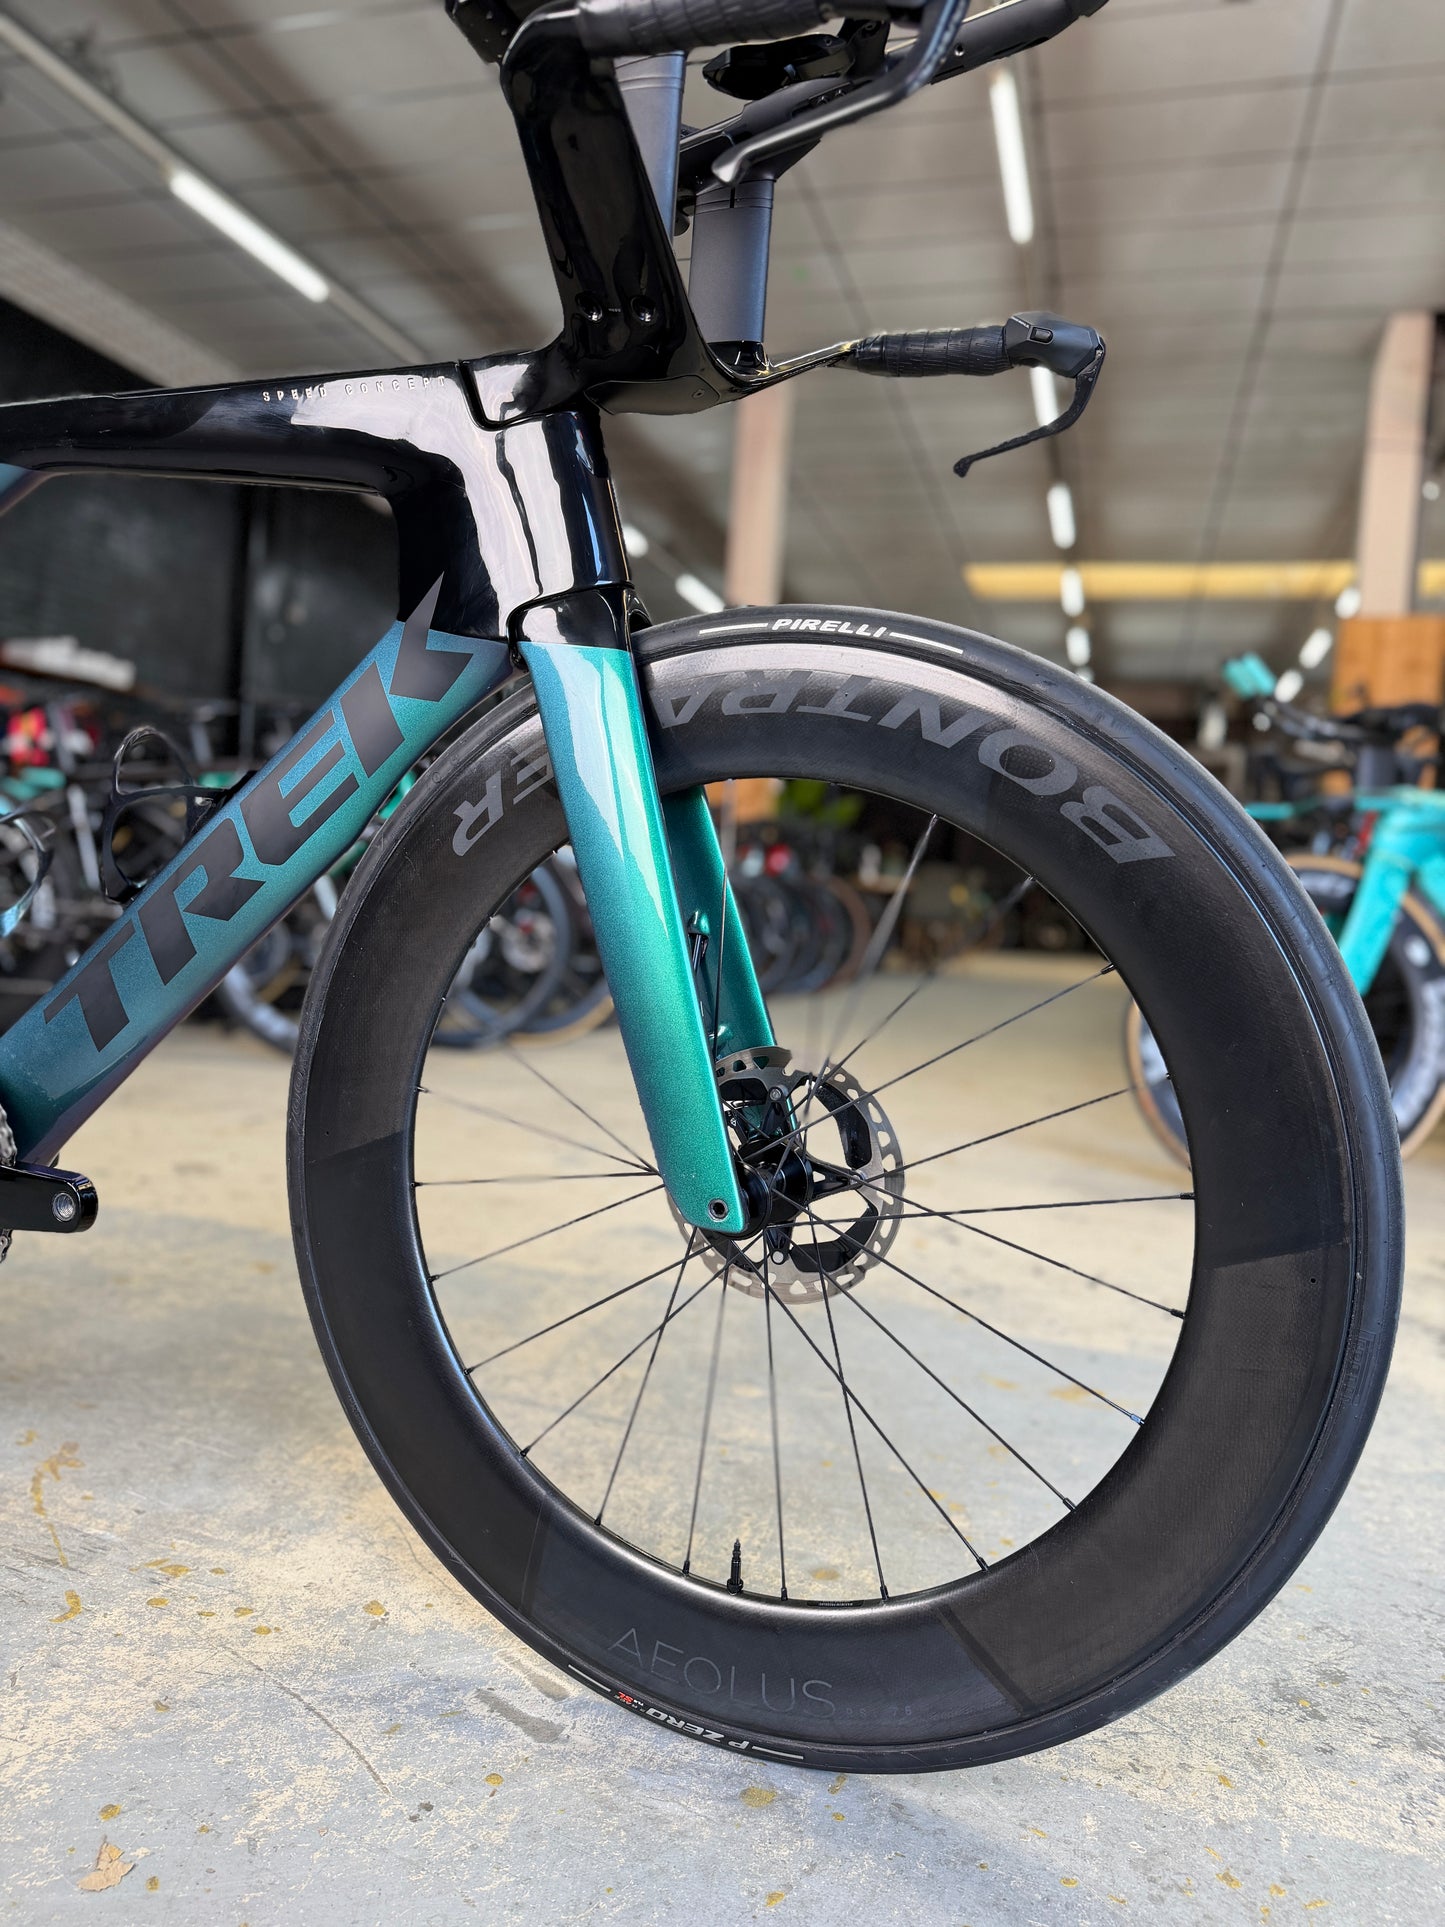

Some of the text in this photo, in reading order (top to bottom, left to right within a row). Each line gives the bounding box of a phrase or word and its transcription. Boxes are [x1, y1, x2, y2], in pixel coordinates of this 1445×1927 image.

[262, 376, 445, 402] SPEED CONCEPT
[771, 618, 888, 639] PIRELLI
[452, 668, 1176, 865] BONTRAER
[43, 571, 474, 1053] TREK
[607, 1628, 837, 1719] AEOLUS
[645, 1707, 750, 1750] P ZERO
